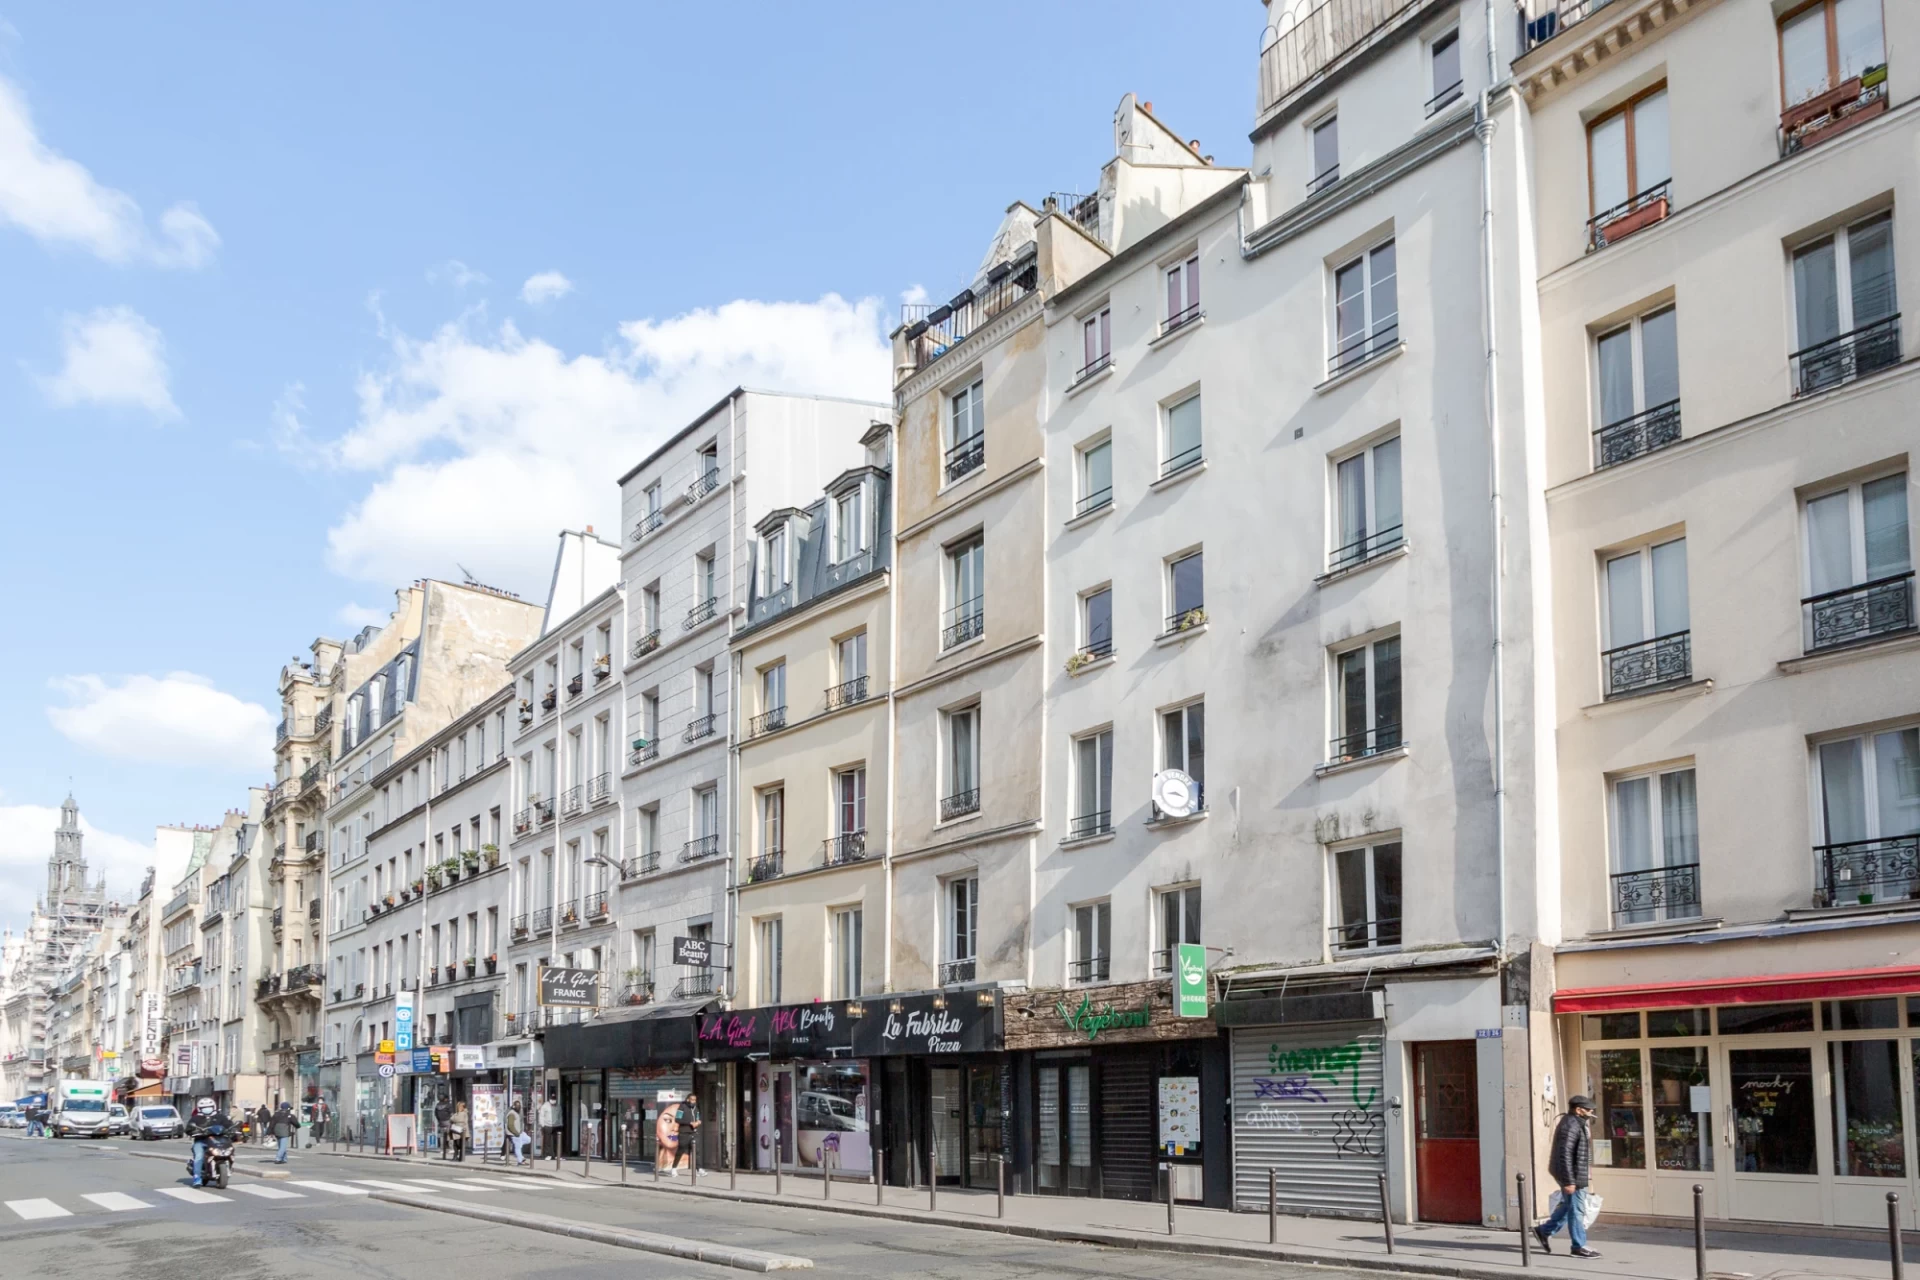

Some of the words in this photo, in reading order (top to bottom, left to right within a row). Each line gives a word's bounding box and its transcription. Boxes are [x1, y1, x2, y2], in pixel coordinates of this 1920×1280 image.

[684, 940, 705, 951] ABC
[679, 947, 709, 962] Beauty
[541, 969, 567, 985] L.A.
[570, 971, 598, 988] Girl
[553, 988, 587, 998] FRANCE
[770, 1007, 799, 1035] ABC
[800, 1004, 836, 1032] Beauty
[882, 1013, 904, 1040] La
[905, 1009, 963, 1038] Fabrika
[699, 1016, 724, 1041] L.A.
[727, 1015, 757, 1047] Girl
[733, 1039, 752, 1047] FRANCE
[792, 1036, 809, 1044] PARIS
[927, 1035, 962, 1053] Pizza
[1659, 1159, 1686, 1168] LOCAL
[1868, 1162, 1902, 1171] TEATIME
